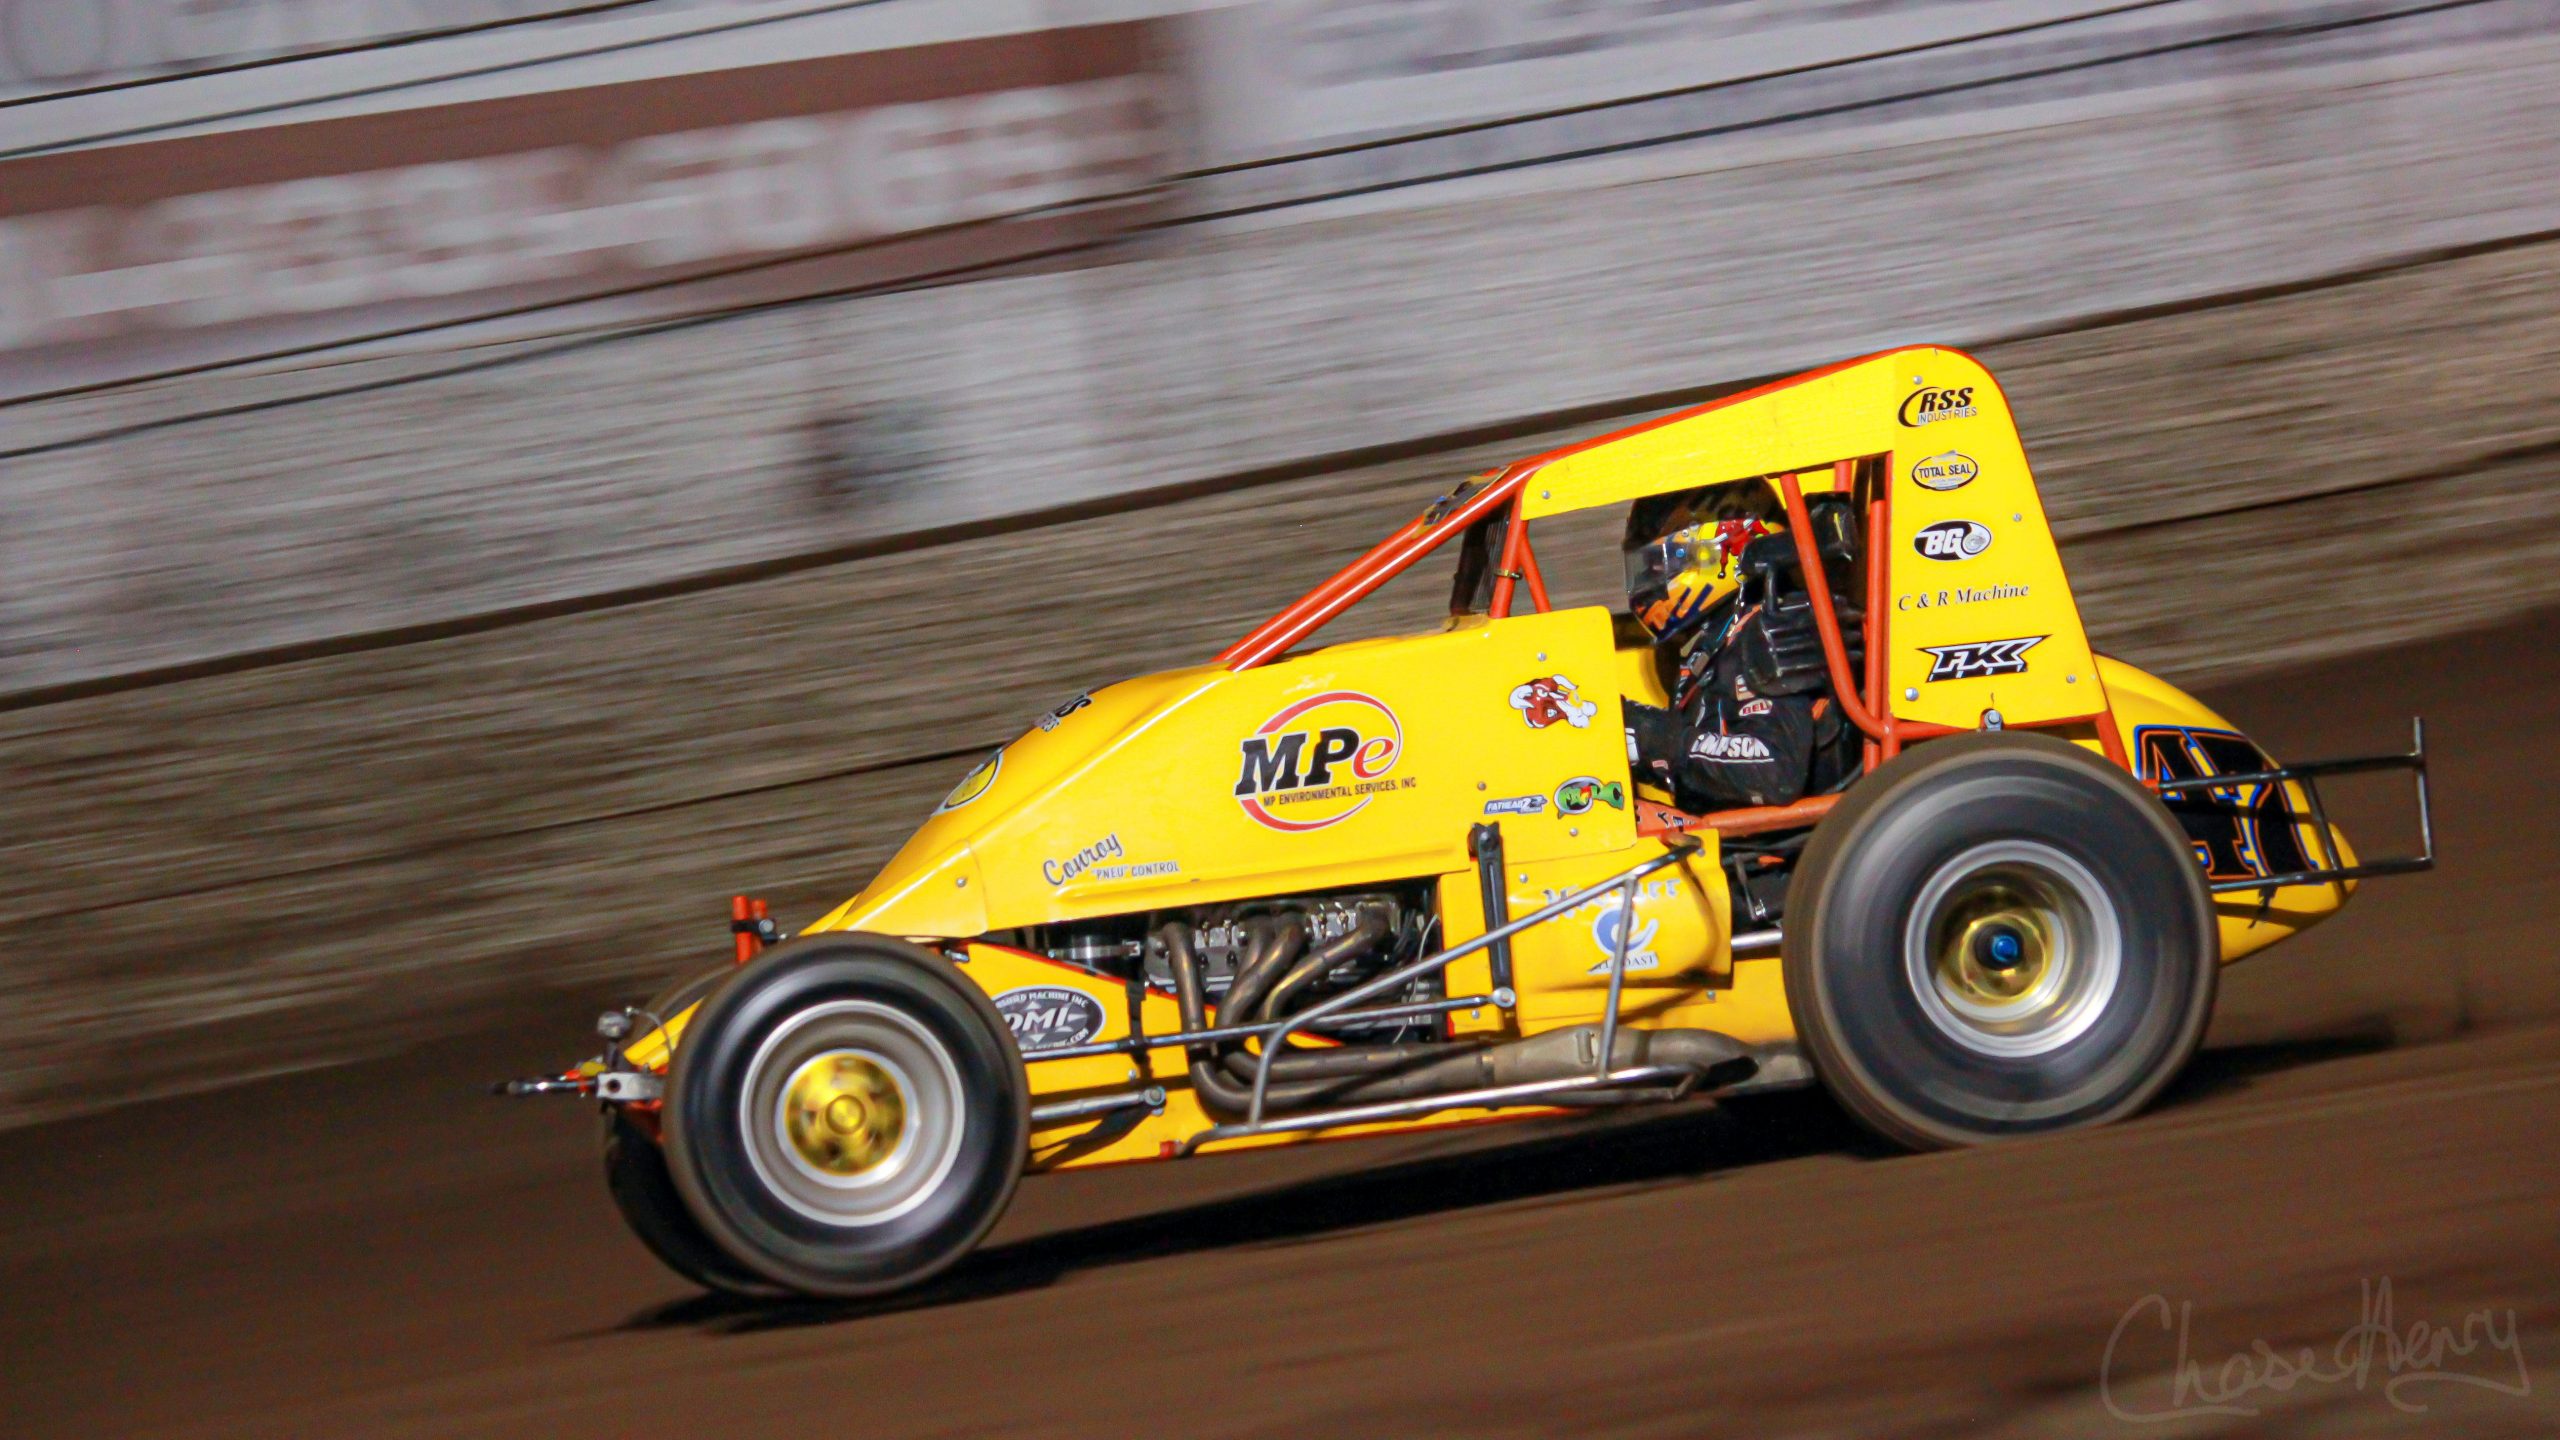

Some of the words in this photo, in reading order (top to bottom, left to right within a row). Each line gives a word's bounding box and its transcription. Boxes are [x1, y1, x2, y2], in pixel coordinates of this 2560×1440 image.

[1918, 386, 1974, 414] RSS
[1916, 406, 1978, 424] INDUSTRIES
[1918, 466, 1945, 479] TOTAL
[1948, 463, 1971, 476] SEAL
[1924, 528, 1964, 556] BG
[1898, 594, 1911, 611] C
[1916, 592, 1930, 609] &
[1937, 591, 1948, 606] R
[1955, 583, 2029, 604] Machine
[1690, 732, 1770, 758] IMPSON
[1235, 727, 1395, 796] MPe
[1263, 796, 1276, 807] MP
[1279, 787, 1352, 805] ENVIRONMENTAL
[1401, 776, 1417, 789] INC
[1131, 861, 1180, 877] CONTROL
